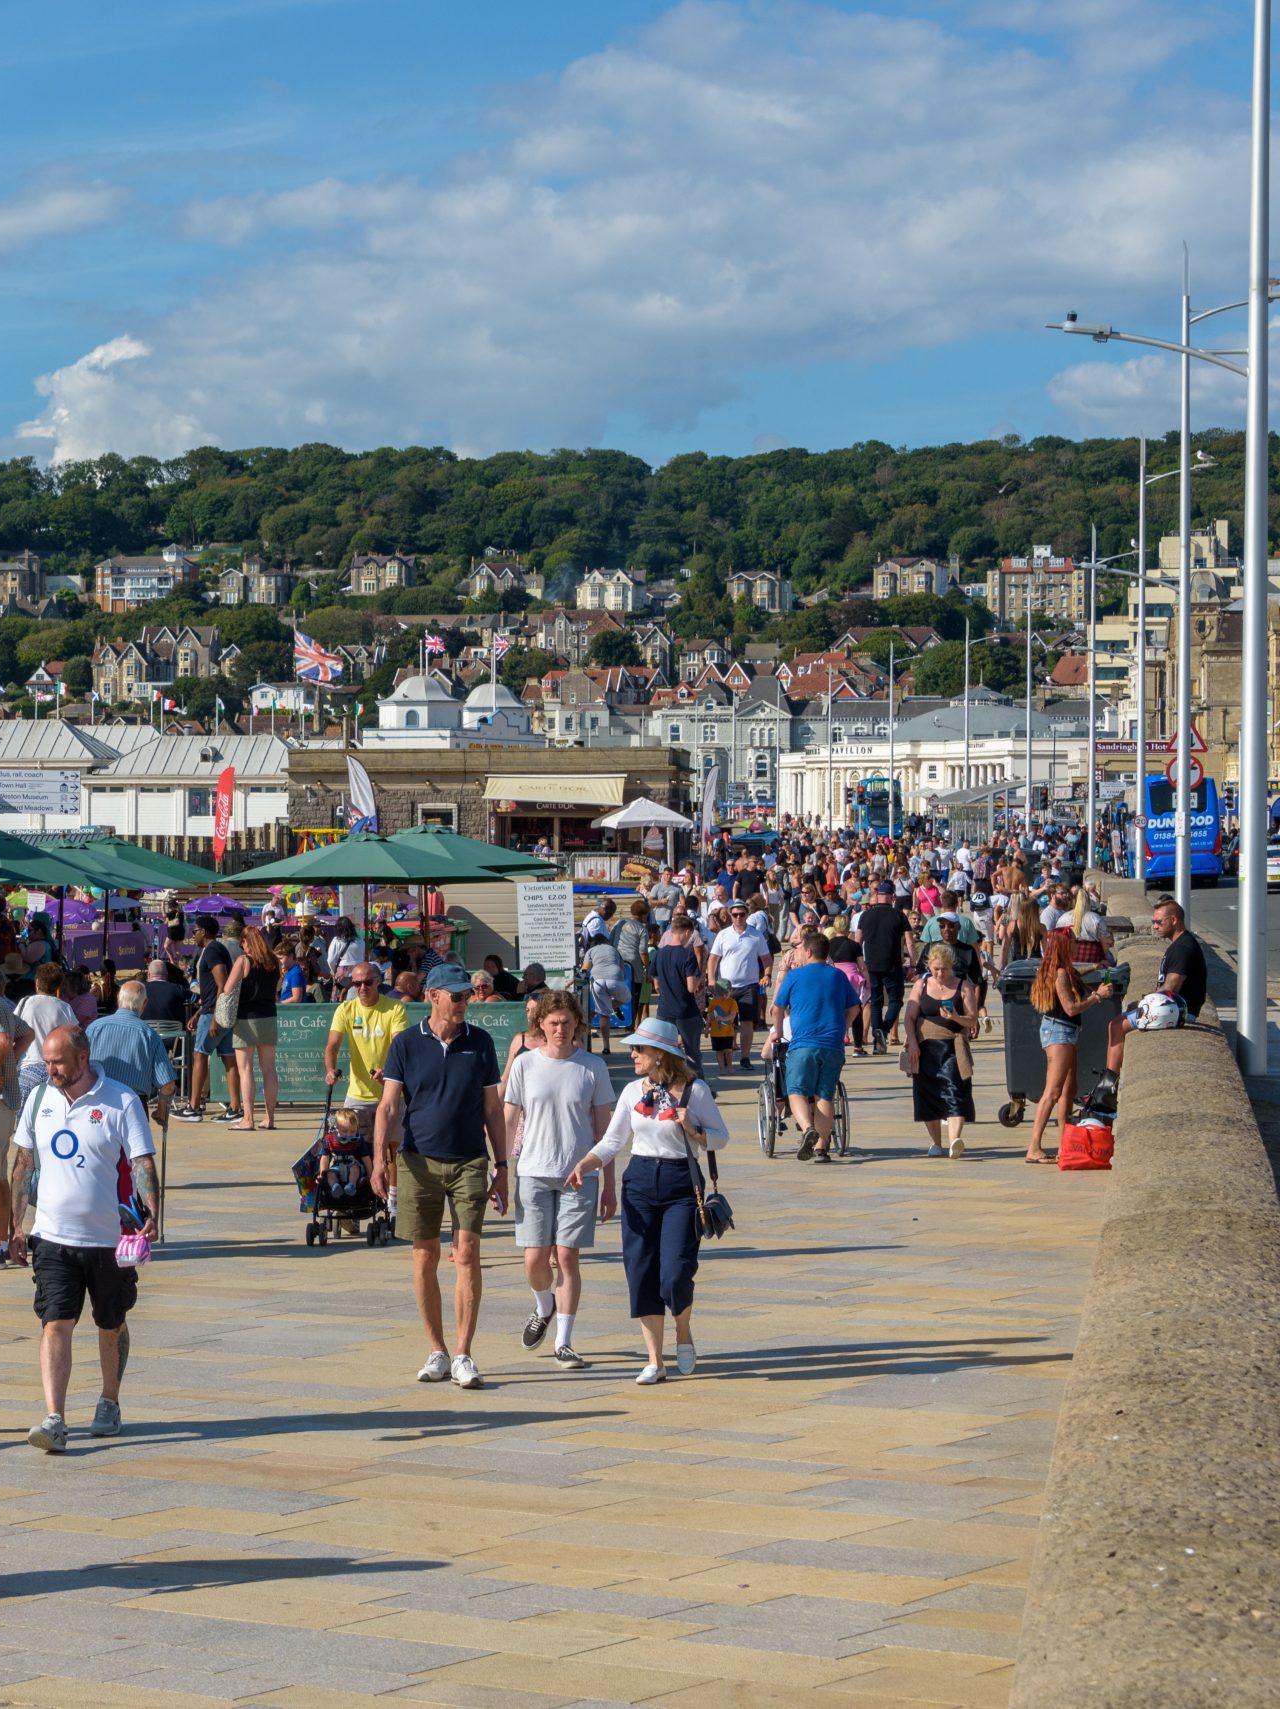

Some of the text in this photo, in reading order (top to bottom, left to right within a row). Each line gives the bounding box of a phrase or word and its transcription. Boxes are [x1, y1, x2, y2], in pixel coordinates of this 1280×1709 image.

[831, 746, 873, 754] PAVILION
[1097, 743, 1169, 752] Sandringh Hot
[536, 802, 557, 810] CARTE
[216, 792, 229, 840] Coca-Cola
[1148, 815, 1214, 829] DUNOOD
[524, 884, 566, 892] Victorian Cafe
[300, 1015, 327, 1028] Cafe
[482, 1014, 509, 1027] Cafe
[51, 1129, 85, 1168] O2
